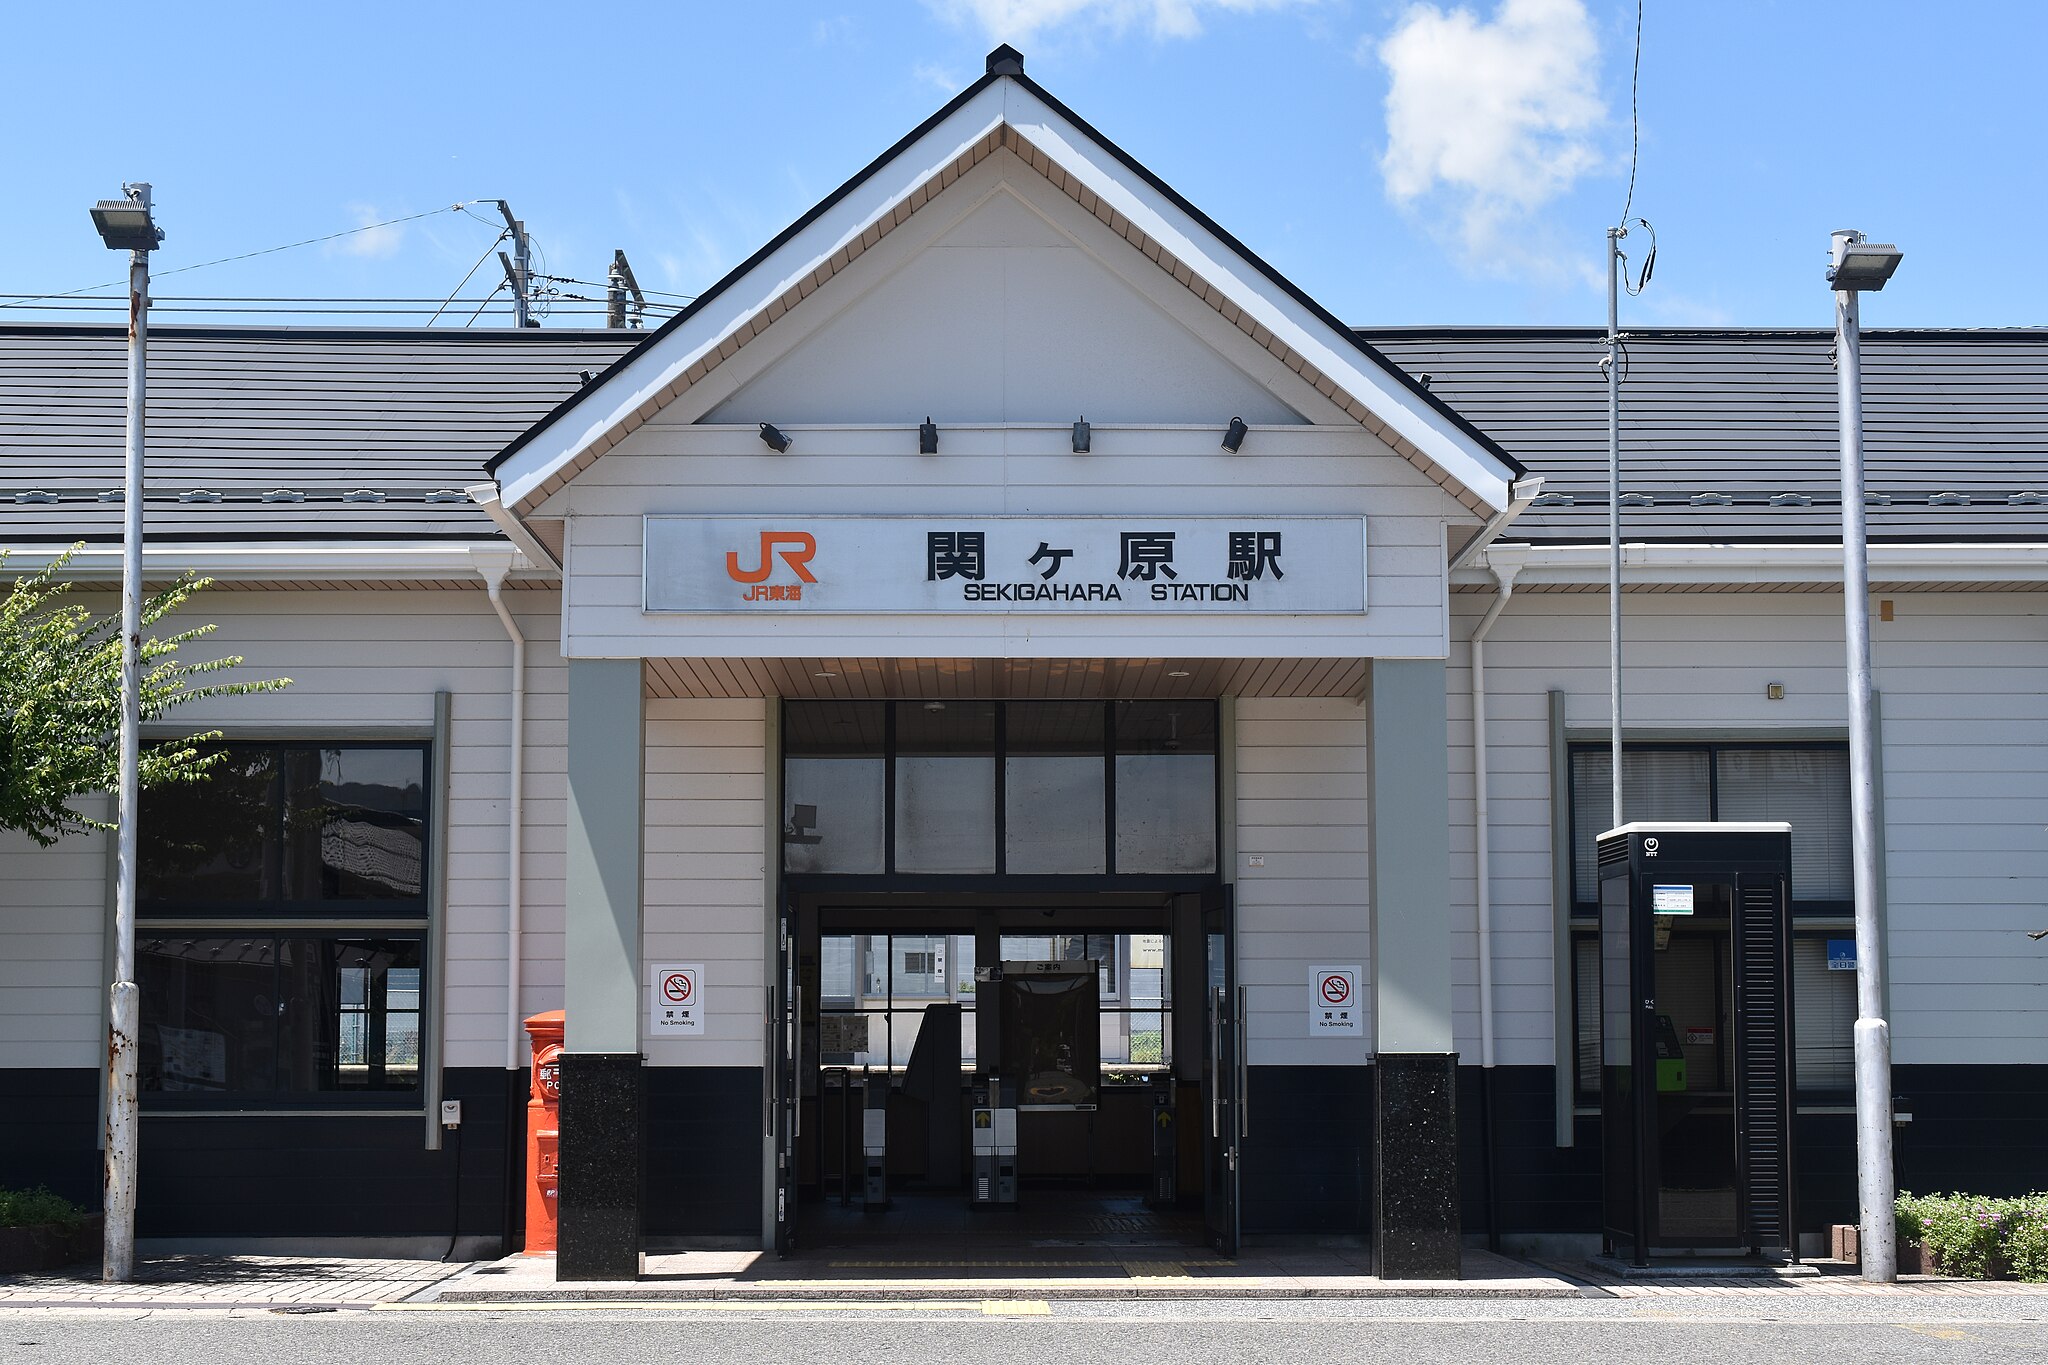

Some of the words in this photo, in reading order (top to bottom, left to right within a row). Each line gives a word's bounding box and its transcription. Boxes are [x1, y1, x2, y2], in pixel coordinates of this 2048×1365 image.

[726, 531, 818, 583] JR
[743, 585, 802, 601] JR東海
[964, 583, 1122, 601] SEKIGAHARA
[1151, 583, 1249, 601] STATION
[666, 1010, 690, 1018] 禁煙
[1324, 1011, 1348, 1020] 禁煙
